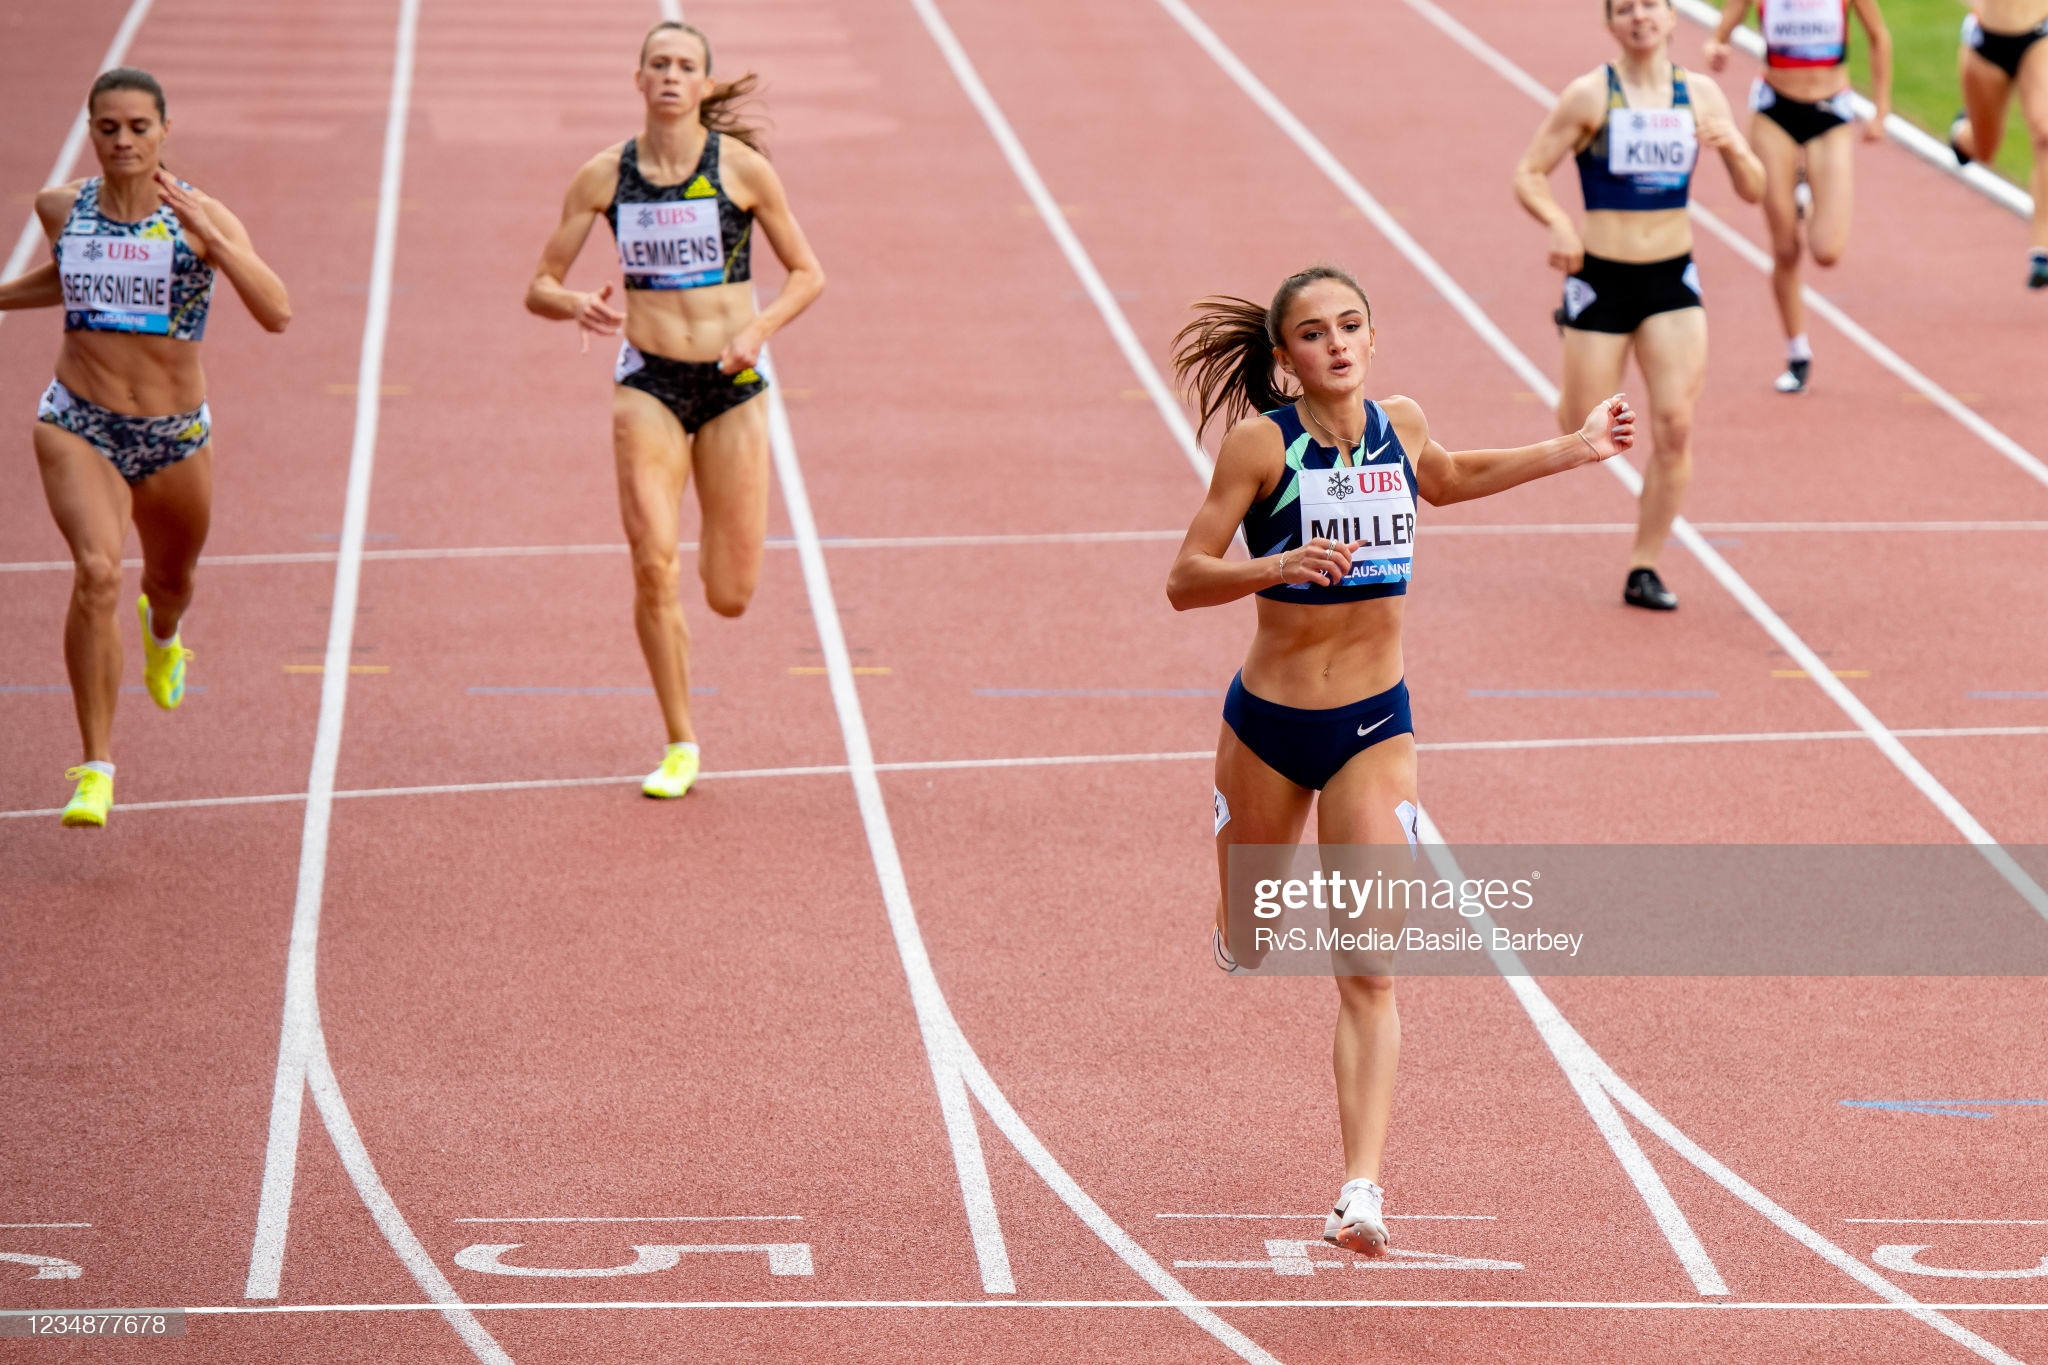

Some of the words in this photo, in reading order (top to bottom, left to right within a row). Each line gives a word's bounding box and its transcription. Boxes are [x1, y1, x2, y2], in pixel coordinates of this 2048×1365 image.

[1625, 140, 1684, 165] KING
[655, 207, 697, 226] UBS
[107, 242, 150, 261] UBS
[621, 236, 719, 267] LEMMENS
[63, 273, 166, 306] SERKSNIENE
[1356, 470, 1402, 494] UBS
[1310, 512, 1415, 547] MILLER
[454, 1242, 814, 1277] 5
[1172, 1238, 1525, 1276] 4
